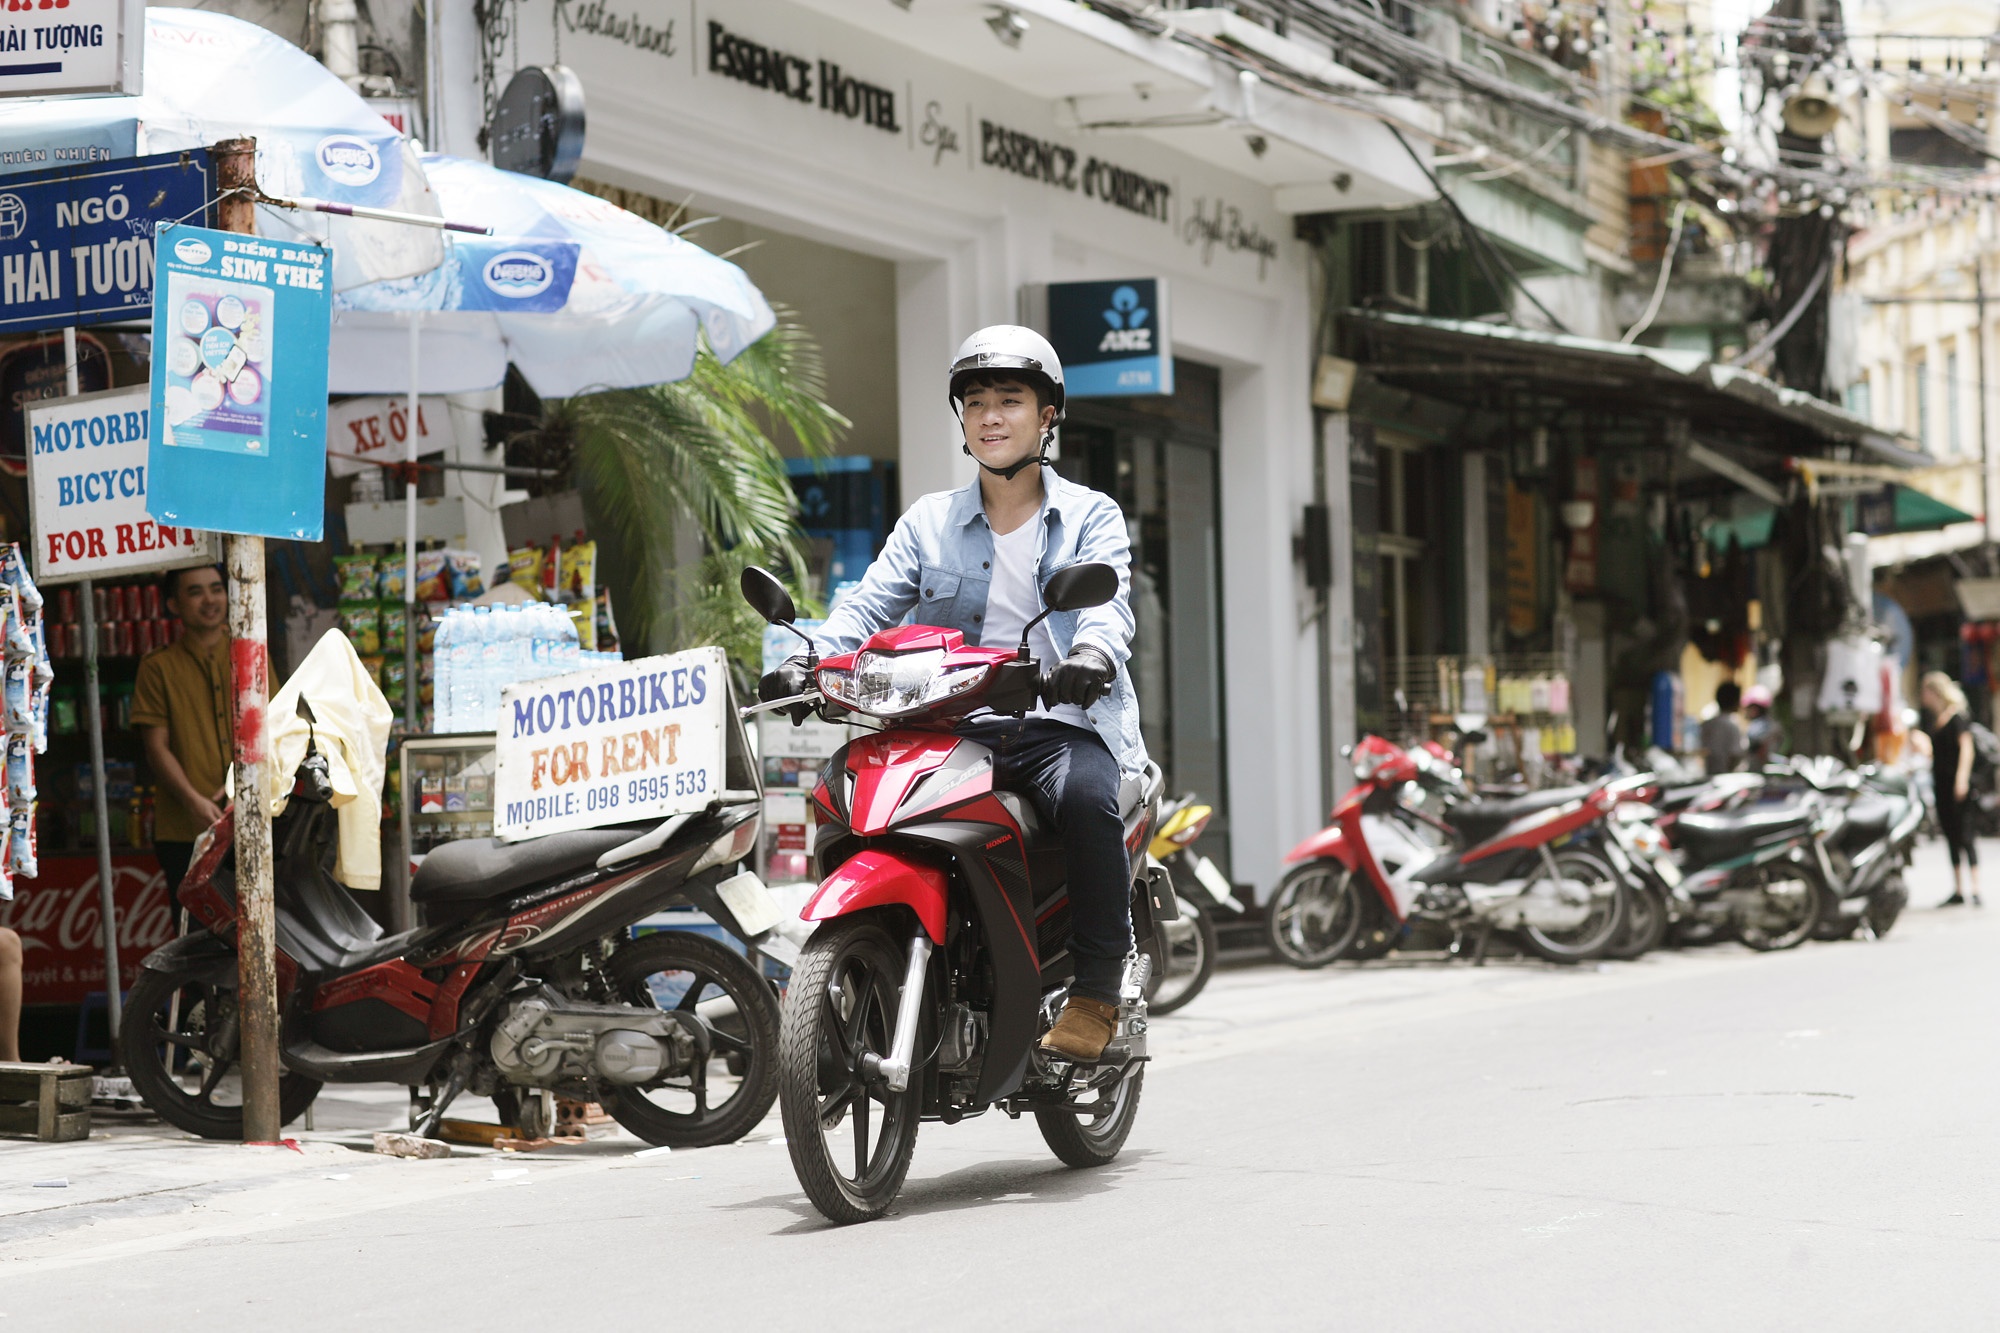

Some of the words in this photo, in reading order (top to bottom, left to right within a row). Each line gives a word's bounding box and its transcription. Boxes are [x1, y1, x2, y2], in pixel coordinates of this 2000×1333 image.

[34, 24, 103, 53] TƯỢNG
[707, 19, 813, 103] ESSENCE
[818, 58, 901, 134] HOTEL
[0, 147, 47, 164] HIÊN
[55, 145, 111, 162] NHIÊN
[56, 184, 130, 229] NGÕ
[3, 240, 60, 304] HÀI
[220, 255, 267, 283] SIM
[1099, 328, 1152, 352] ANZ
[348, 415, 386, 454] XE
[47, 527, 108, 563] FOR
[512, 664, 707, 739] MOTORBIKES
[530, 740, 591, 791] FOR
[600, 723, 682, 778] RENT
[506, 792, 581, 826] MOBILE:
[586, 783, 620, 811] 098
[628, 775, 670, 804] 9595
[675, 768, 707, 797] 533
[985, 833, 1013, 850] HONDA
